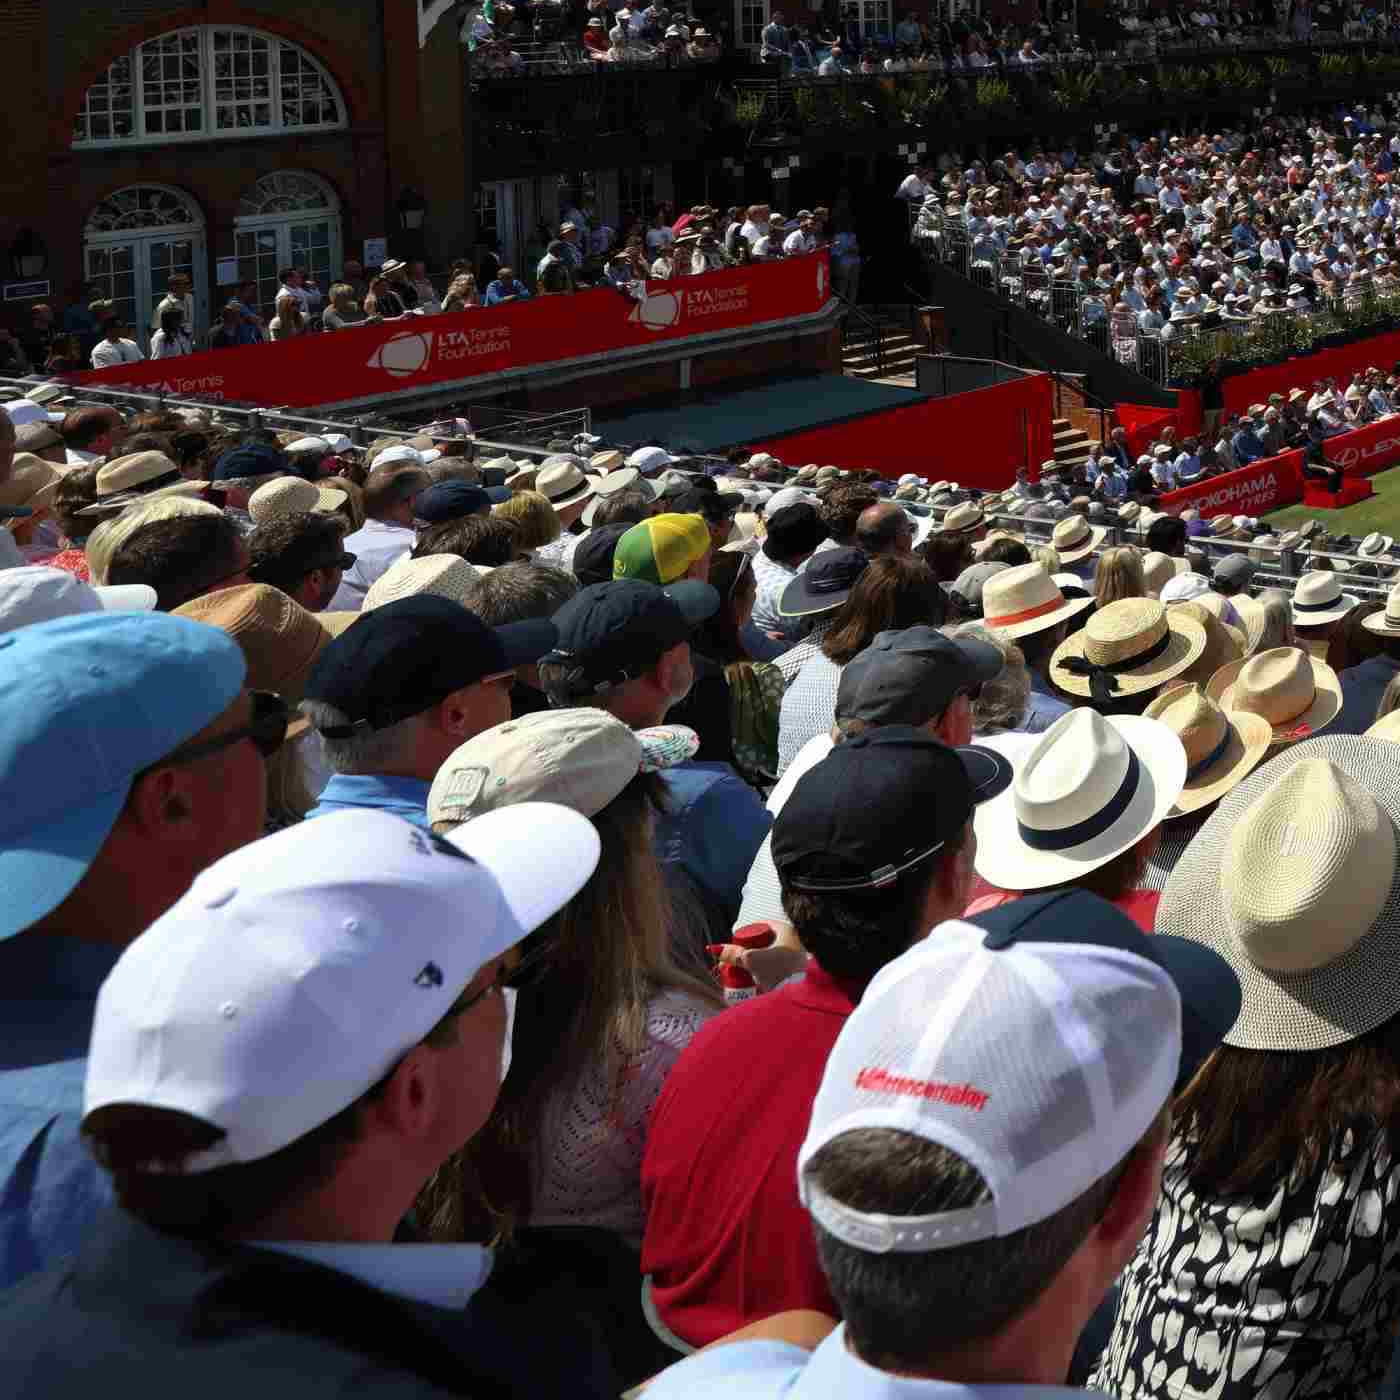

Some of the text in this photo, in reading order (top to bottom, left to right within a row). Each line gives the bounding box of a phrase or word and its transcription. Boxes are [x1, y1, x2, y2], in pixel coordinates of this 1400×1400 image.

[438, 326, 512, 346] LTA Tennis
[438, 339, 512, 360] Foundation
[175, 375, 224, 393] Tennis
[1239, 489, 1276, 510] TYRES
